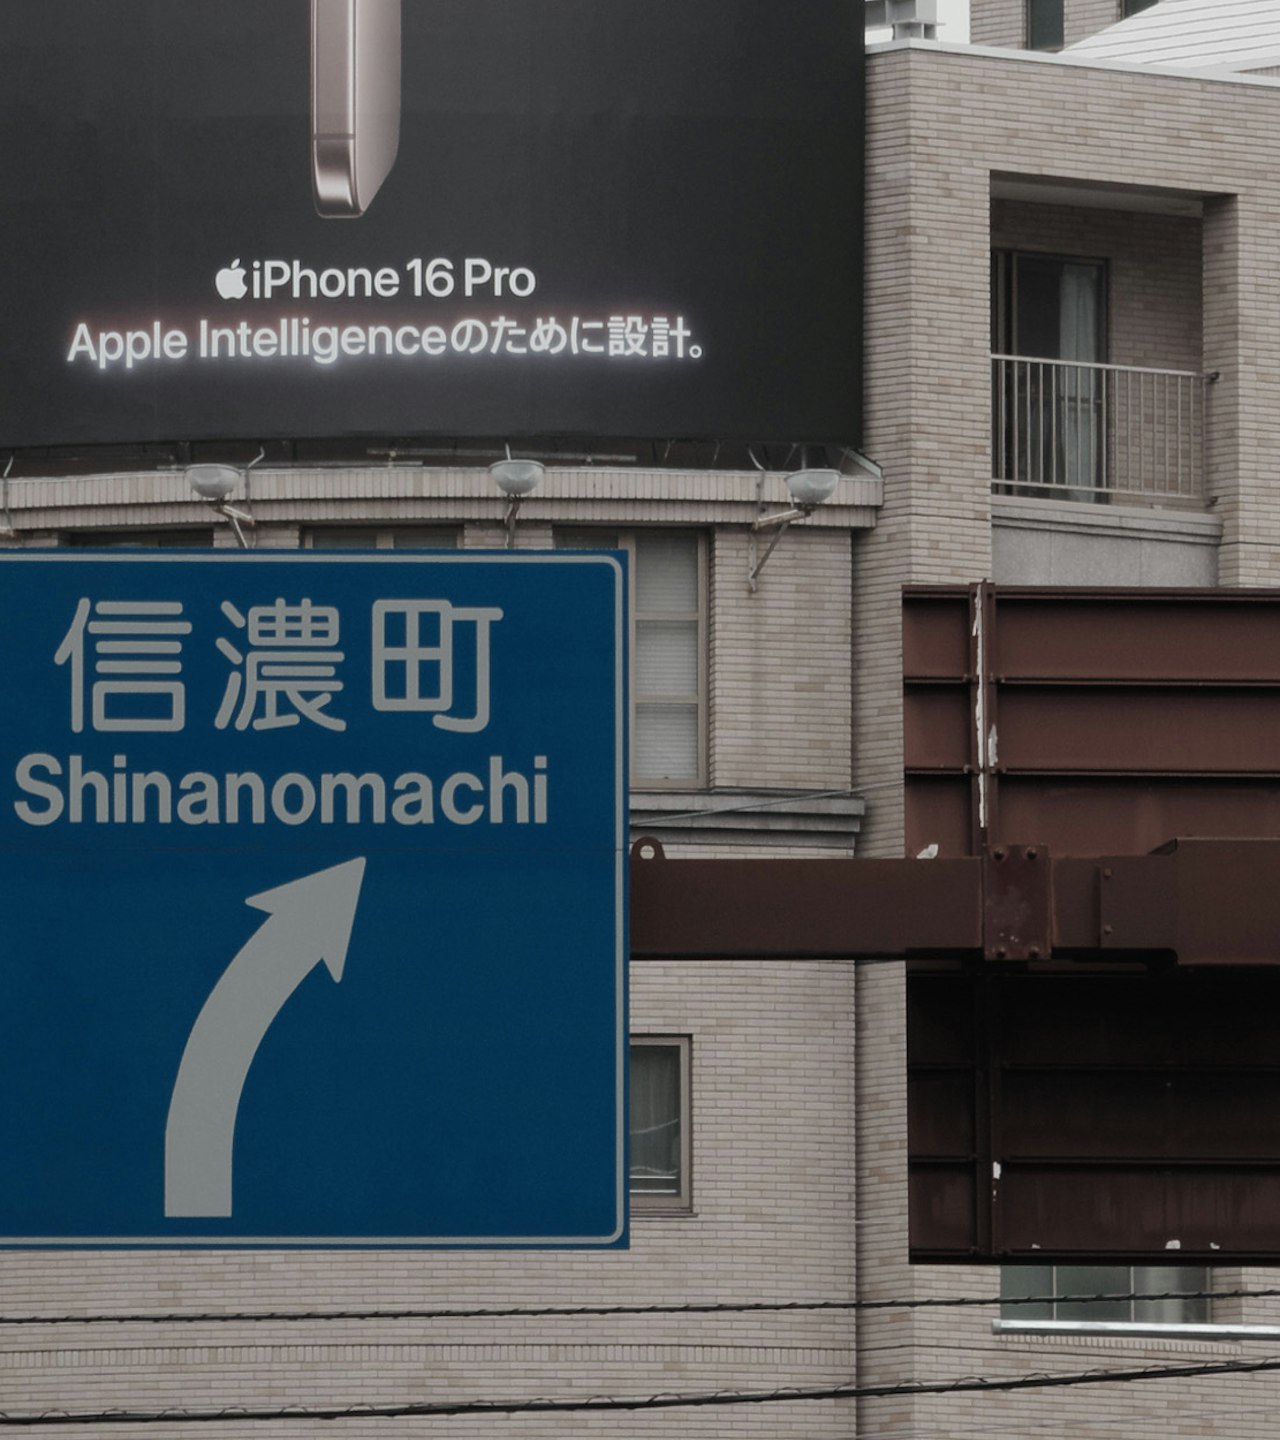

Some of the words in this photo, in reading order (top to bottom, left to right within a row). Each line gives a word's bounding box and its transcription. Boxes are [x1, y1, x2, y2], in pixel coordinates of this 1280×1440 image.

[251, 260, 400, 299] iPhone
[405, 257, 455, 298] 16
[464, 257, 536, 298] Pro
[67, 320, 188, 369] Apple
[53, 596, 504, 734] 信濃町
[13, 752, 548, 827] Shinanomachi
